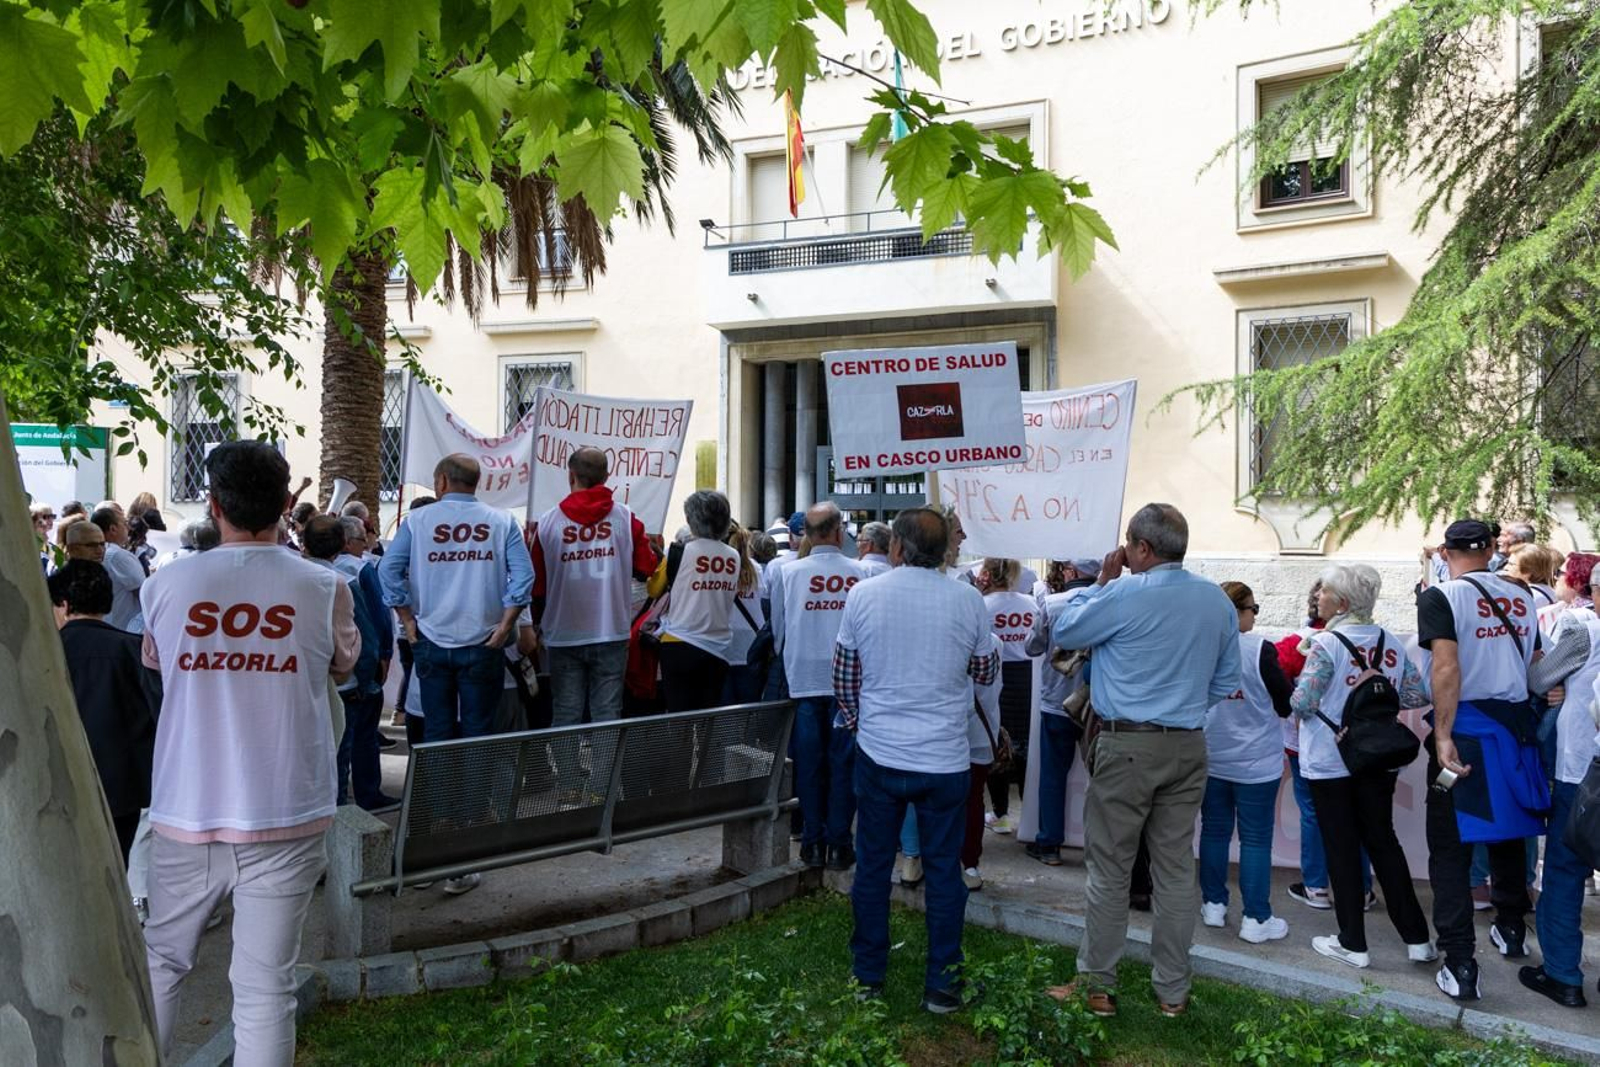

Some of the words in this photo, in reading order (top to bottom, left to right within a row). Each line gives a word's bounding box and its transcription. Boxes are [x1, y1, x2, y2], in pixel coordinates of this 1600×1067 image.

[936, 30, 982, 61] EL
[999, 0, 1173, 53] GOBIERNO
[831, 357, 911, 376] CENTRO
[915, 356, 940, 372] DE
[946, 353, 1007, 370] SALUD
[33, 431, 41, 439] de
[845, 454, 870, 470] EN
[877, 450, 941, 468] CASCO
[946, 445, 1022, 462] URBANO
[433, 523, 491, 544] SOS
[562, 521, 612, 544] SOS
[428, 550, 494, 563] CAZORLA
[560, 546, 615, 562] CAZORLA
[695, 555, 737, 575] SOS
[809, 574, 859, 594] SOS
[804, 599, 846, 611] CAZOR
[1476, 597, 1527, 618] SOS
[184, 601, 296, 639] SOS
[994, 612, 1033, 629] SOS
[178, 651, 298, 673] CAZORLA
